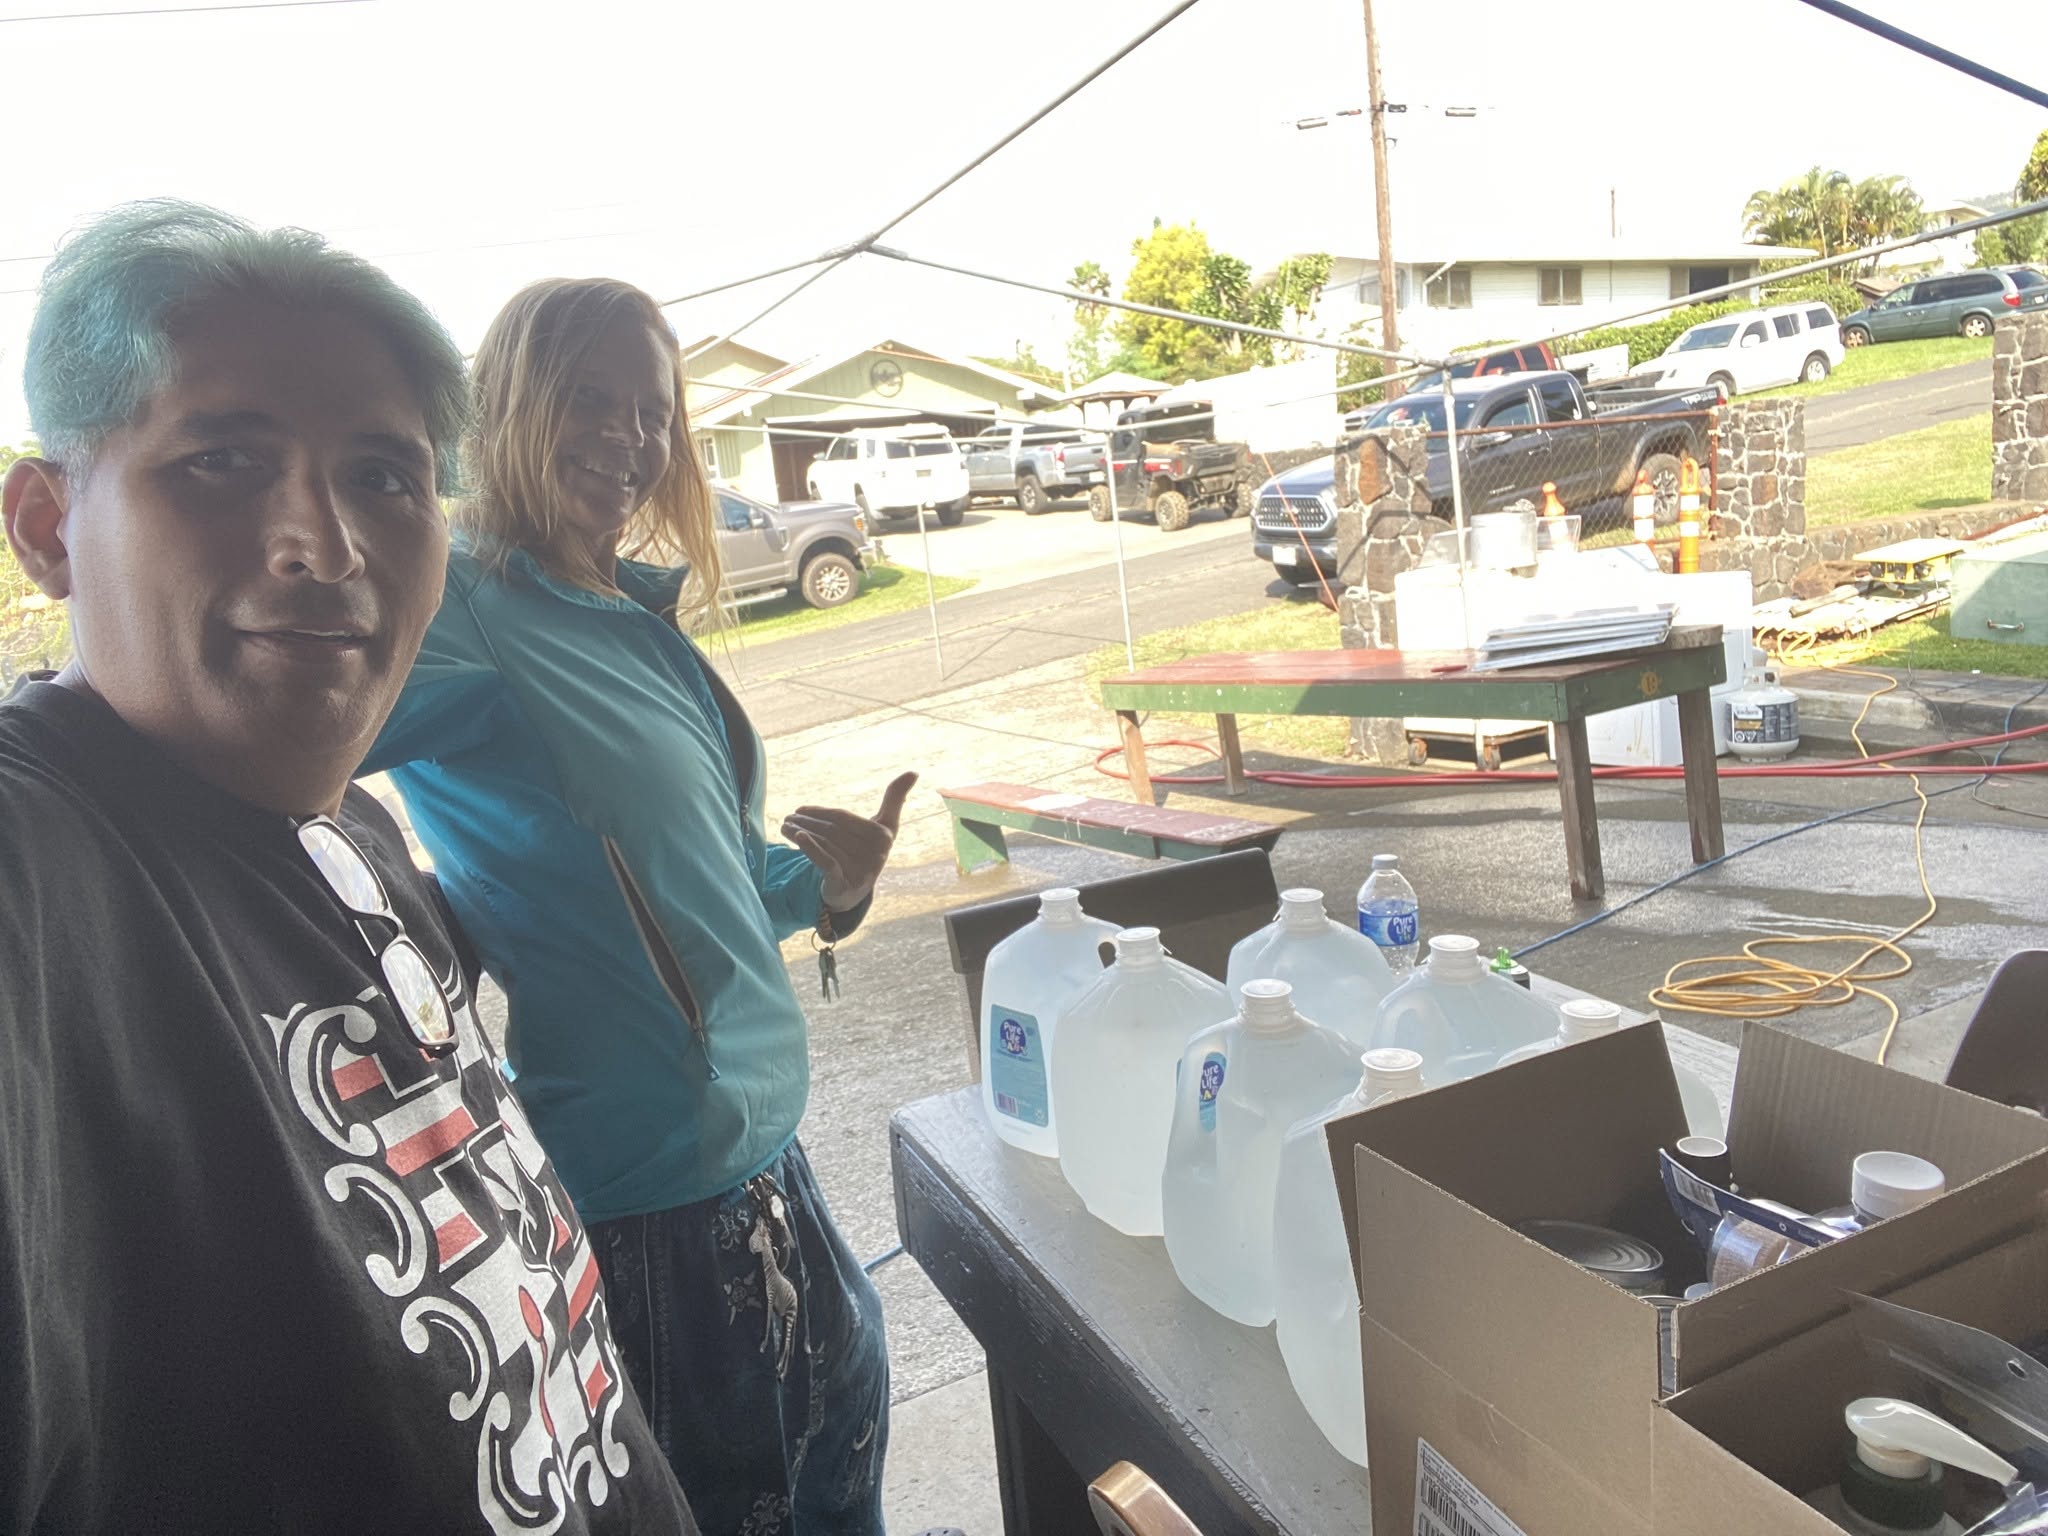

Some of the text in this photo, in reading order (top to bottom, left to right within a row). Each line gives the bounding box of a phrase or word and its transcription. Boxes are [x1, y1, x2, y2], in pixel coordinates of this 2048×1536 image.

[1392, 915, 1413, 927] Pure
[1396, 924, 1412, 936] Life
[1003, 1021, 1022, 1035] Pure
[1006, 1031, 1021, 1045] Life
[1202, 1064, 1219, 1077] ure
[1202, 1075, 1218, 1089] Life
